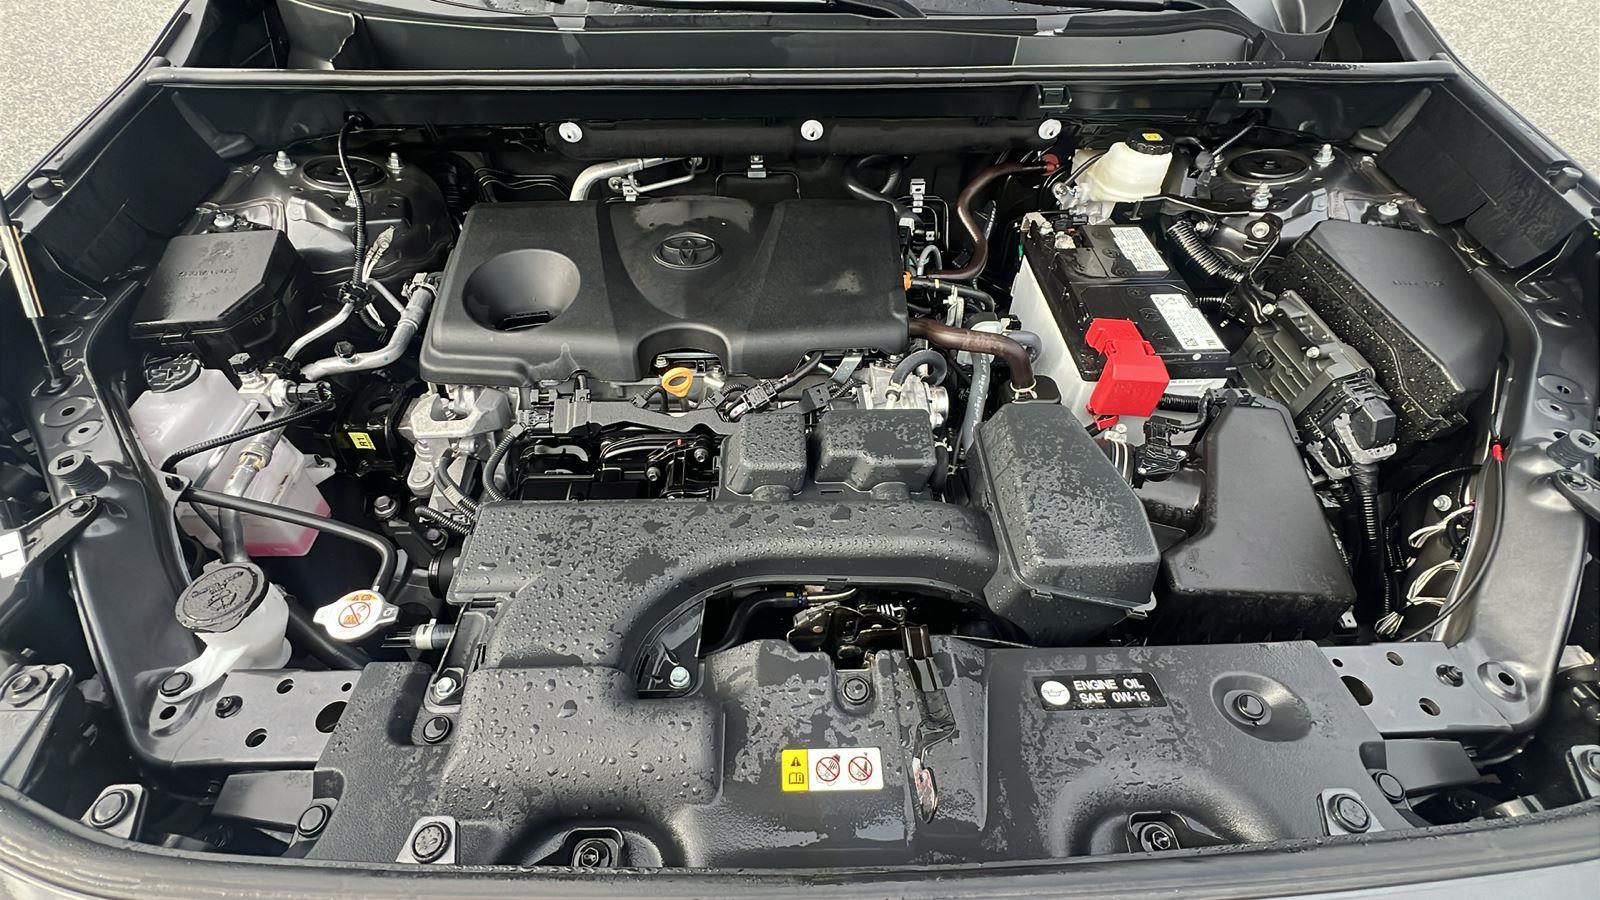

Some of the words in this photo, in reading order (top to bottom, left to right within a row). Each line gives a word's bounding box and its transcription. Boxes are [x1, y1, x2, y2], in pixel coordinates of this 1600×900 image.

[1073, 679, 1118, 691] ENGINE
[1123, 678, 1145, 689] OIL
[1080, 693, 1106, 704] SAE
[1111, 691, 1151, 702] 0W-16
